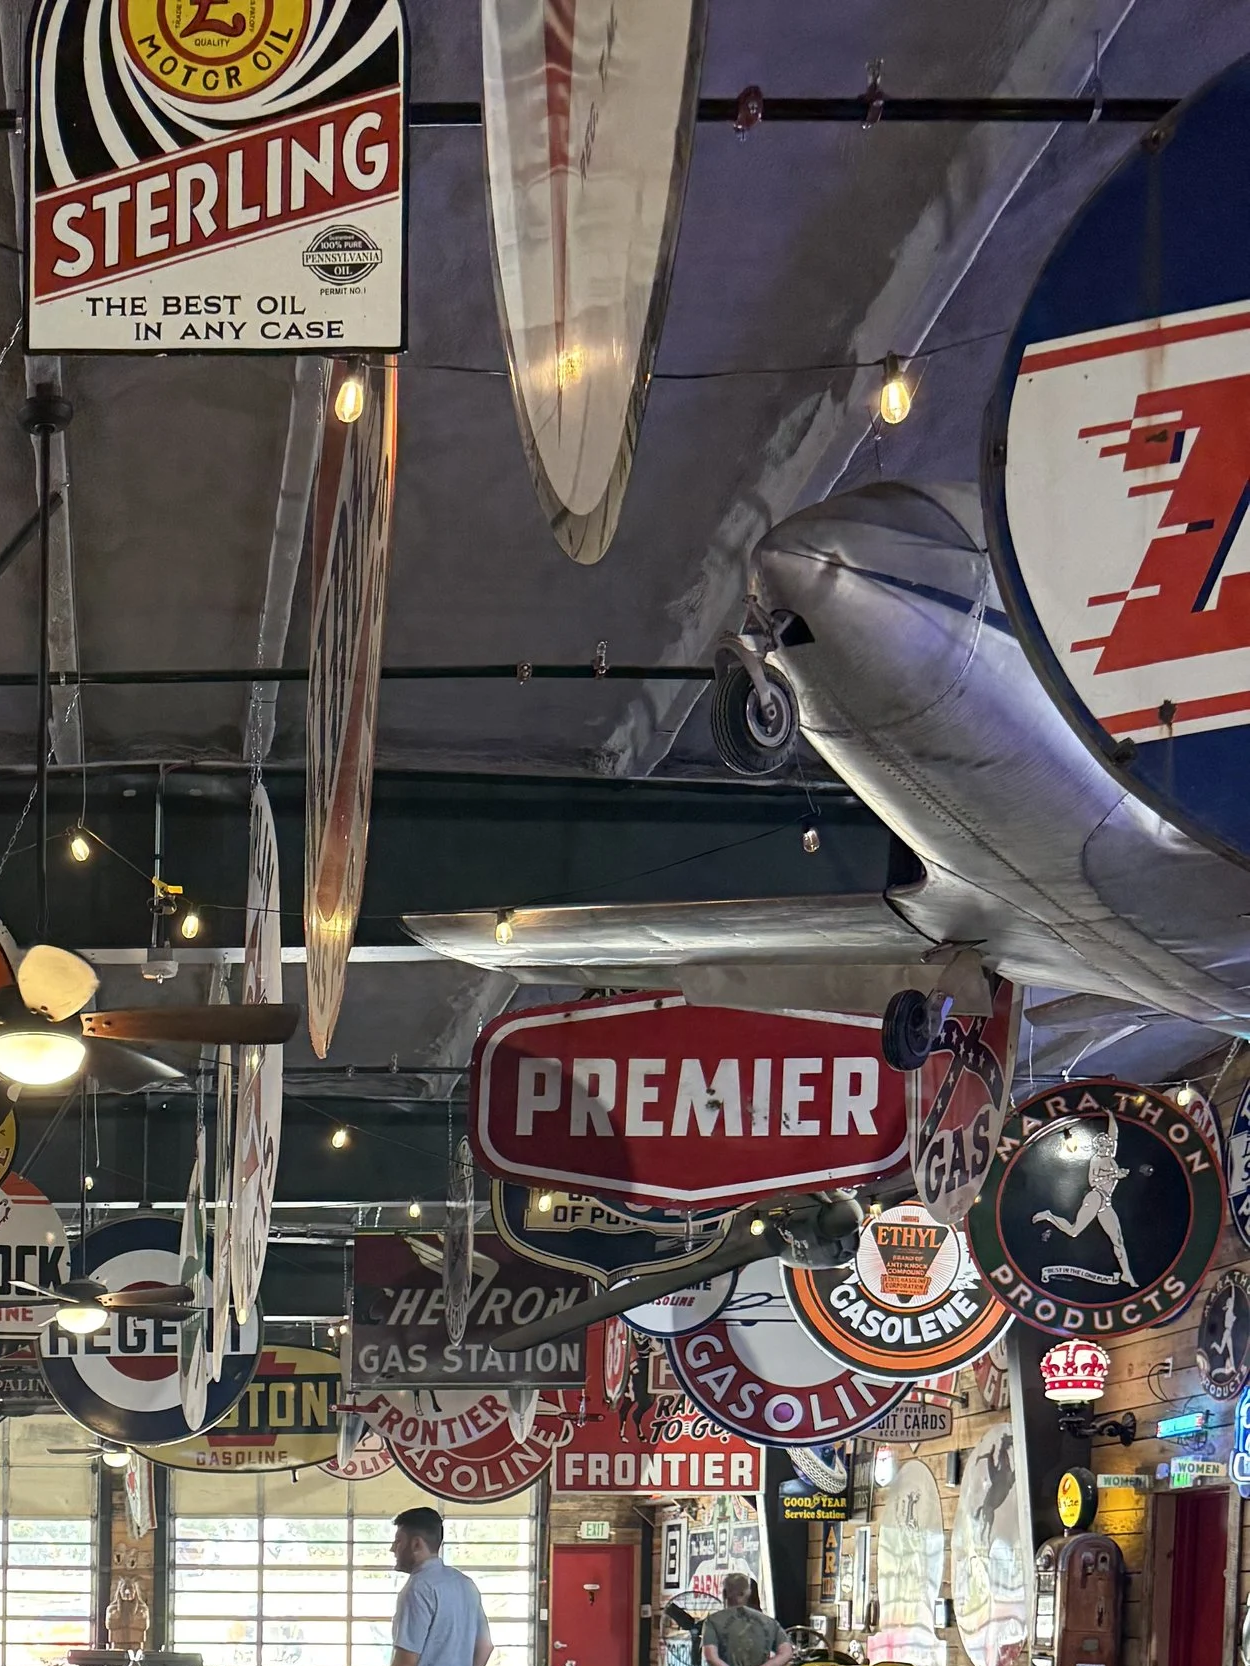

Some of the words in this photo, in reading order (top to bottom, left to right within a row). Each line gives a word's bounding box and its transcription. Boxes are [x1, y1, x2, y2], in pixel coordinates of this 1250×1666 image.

[194, 38, 230, 48] QUALITY
[136, 33, 242, 92] MOTOR
[252, 26, 294, 73] OIL
[51, 110, 390, 278] STERLING
[343, 240, 363, 249] PURE
[305, 251, 380, 264] PENNSYLVANIA
[334, 265, 353, 276] OIL
[319, 287, 348, 296] PERMIT
[85, 296, 148, 317] THE
[162, 295, 241, 316] BEST
[256, 295, 307, 316] OIL
[134, 321, 163, 341] IN
[179, 320, 248, 341] ANY
[259, 319, 345, 340] CASE
[515, 1056, 880, 1138] PREMIER
[994, 1090, 1213, 1177] MARATHON
[924, 1103, 992, 1205] GAS
[553, 1205, 583, 1223] OF
[876, 1225, 942, 1249] ETHYL
[989, 1262, 1190, 1333] PRODUCTS
[829, 1284, 980, 1346] GASOLENE
[358, 1343, 428, 1374] GAS
[442, 1342, 581, 1373] STATION
[369, 1393, 509, 1447] FRONTIER
[650, 1419, 684, 1443] TO
[904, 1413, 947, 1431] CARDS
[878, 1430, 922, 1438] ACCEPTED
[195, 1449, 289, 1467] GASOLINE
[1178, 1462, 1220, 1475] WOMEN
[563, 1452, 754, 1488] FRONTIER
[1103, 1476, 1144, 1487] WOMEN
[783, 1509, 817, 1519] Service
[816, 1508, 846, 1519] Station
[586, 1522, 605, 1537] EXIT
